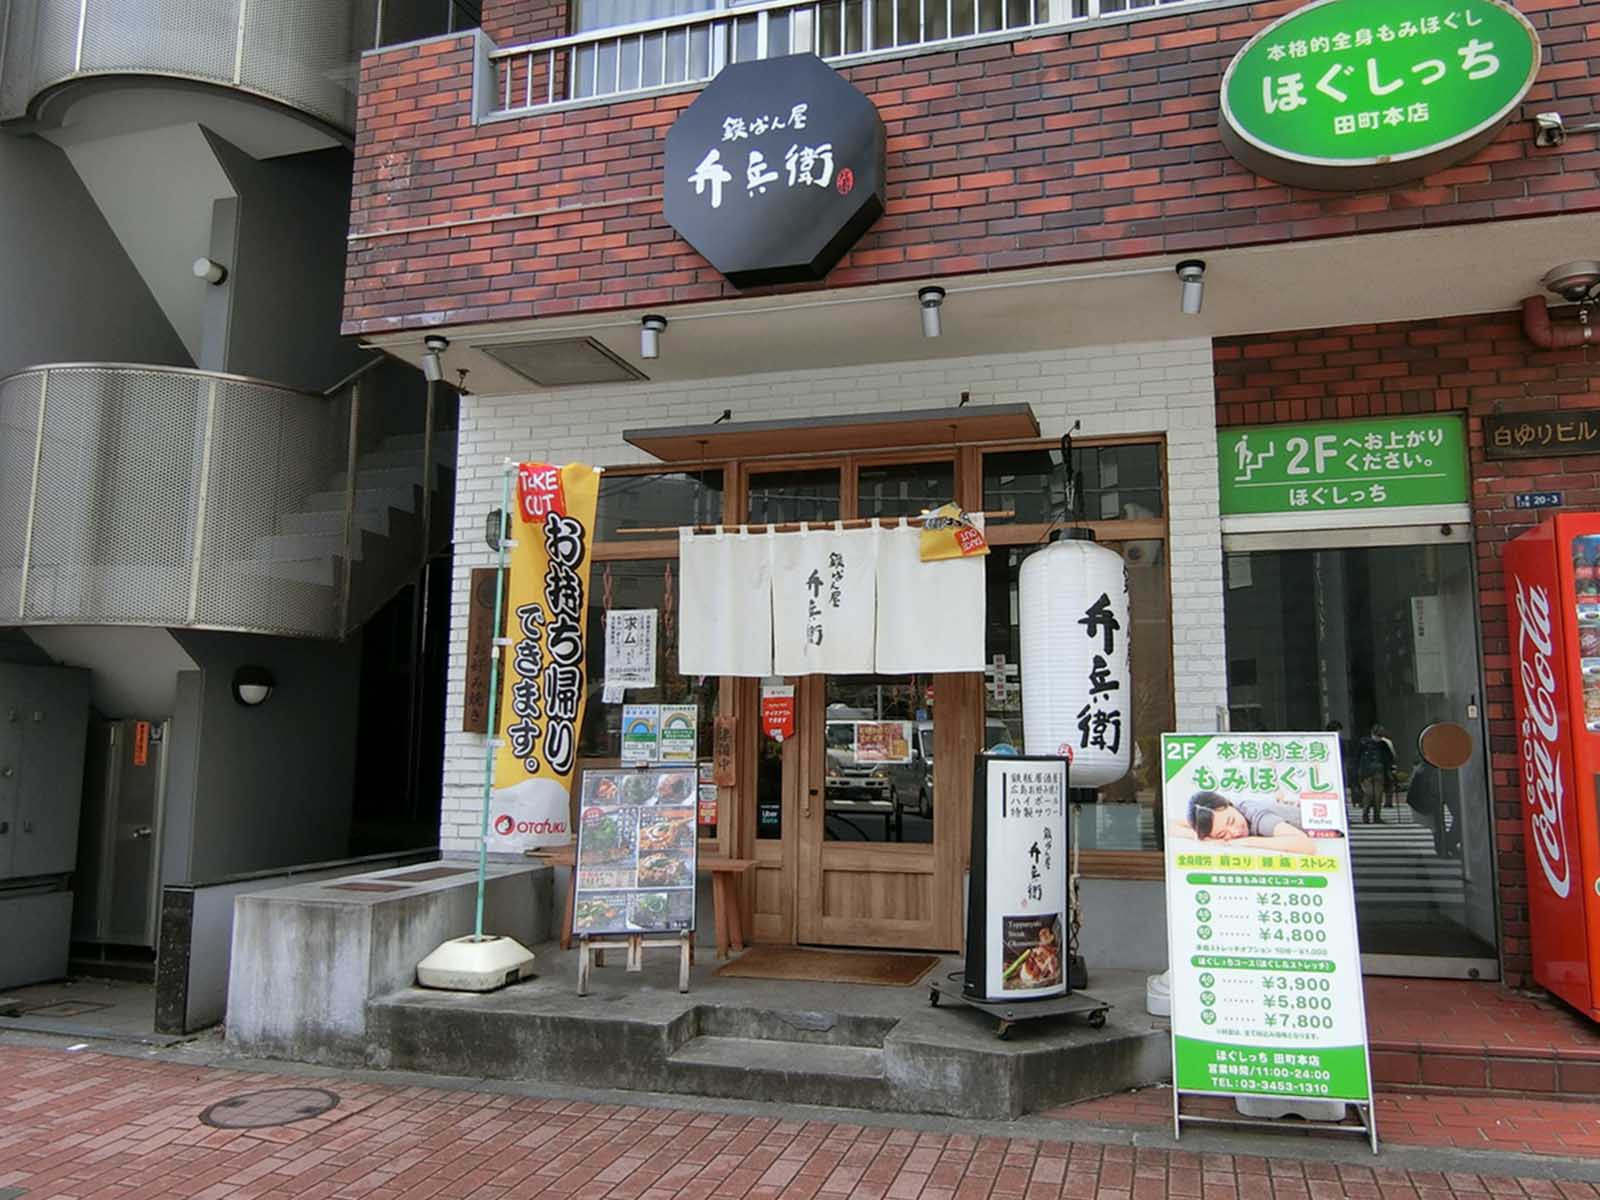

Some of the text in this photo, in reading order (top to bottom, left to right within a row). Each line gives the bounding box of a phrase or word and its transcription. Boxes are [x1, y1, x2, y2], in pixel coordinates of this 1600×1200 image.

[1266, 9, 1483, 61] 本格的全身もみほぐし
[1262, 38, 1500, 115] ほぐしっち
[1333, 102, 1430, 135] 田町本店
[1494, 421, 1598, 447] 白ゆりビル
[1286, 434, 1338, 475] 2F
[1345, 450, 1434, 472] ください。
[1288, 484, 1388, 507] ほぐしっち
[543, 511, 585, 775] お持ち帰り
[1077, 592, 1121, 755] 弁兵衛
[507, 604, 544, 773] できます。
[1513, 573, 1570, 898] Coca-Cola
[1167, 742, 1197, 760] 2F
[1216, 741, 1329, 761] 本格的全身
[1191, 765, 1332, 792] もみほぐし
[1299, 857, 1337, 869] ストレス
[1256, 892, 1323, 907] ¥2,800
[1257, 910, 1325, 925] ¥3,800
[1259, 927, 1327, 942] ¥4,800
[1262, 976, 1330, 992] ¥3,900
[1263, 994, 1332, 1010] ¥5,800
[1265, 1012, 1333, 1029] ¥7,800
[1215, 1049, 1320, 1067] ほぐしっち 田町本店
